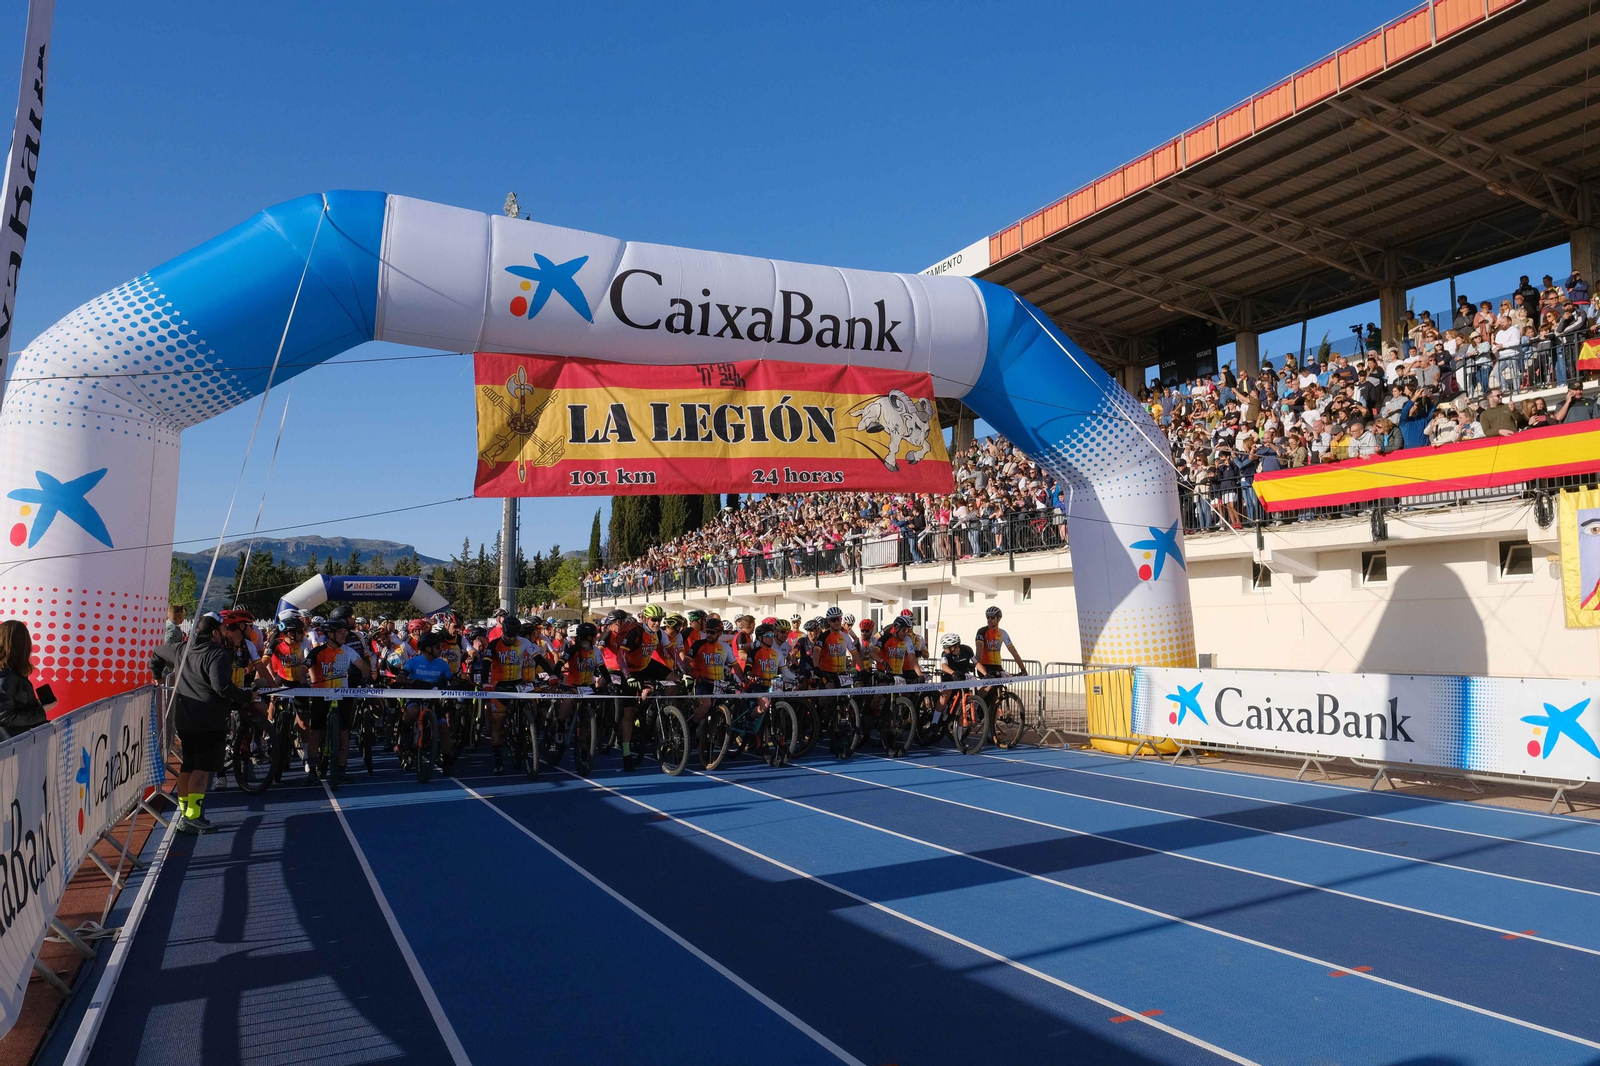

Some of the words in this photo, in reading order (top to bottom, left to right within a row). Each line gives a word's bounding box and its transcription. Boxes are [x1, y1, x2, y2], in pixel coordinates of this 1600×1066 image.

[609, 269, 903, 353] CaixaBank
[1161, 360, 1177, 369] LOCAL
[566, 402, 637, 444] LA
[649, 395, 838, 444] LEGIÓN
[568, 470, 610, 486] 101
[616, 467, 657, 485] km
[752, 468, 780, 486] 24
[784, 466, 845, 484] horas
[1214, 686, 1415, 743] CaixaBank
